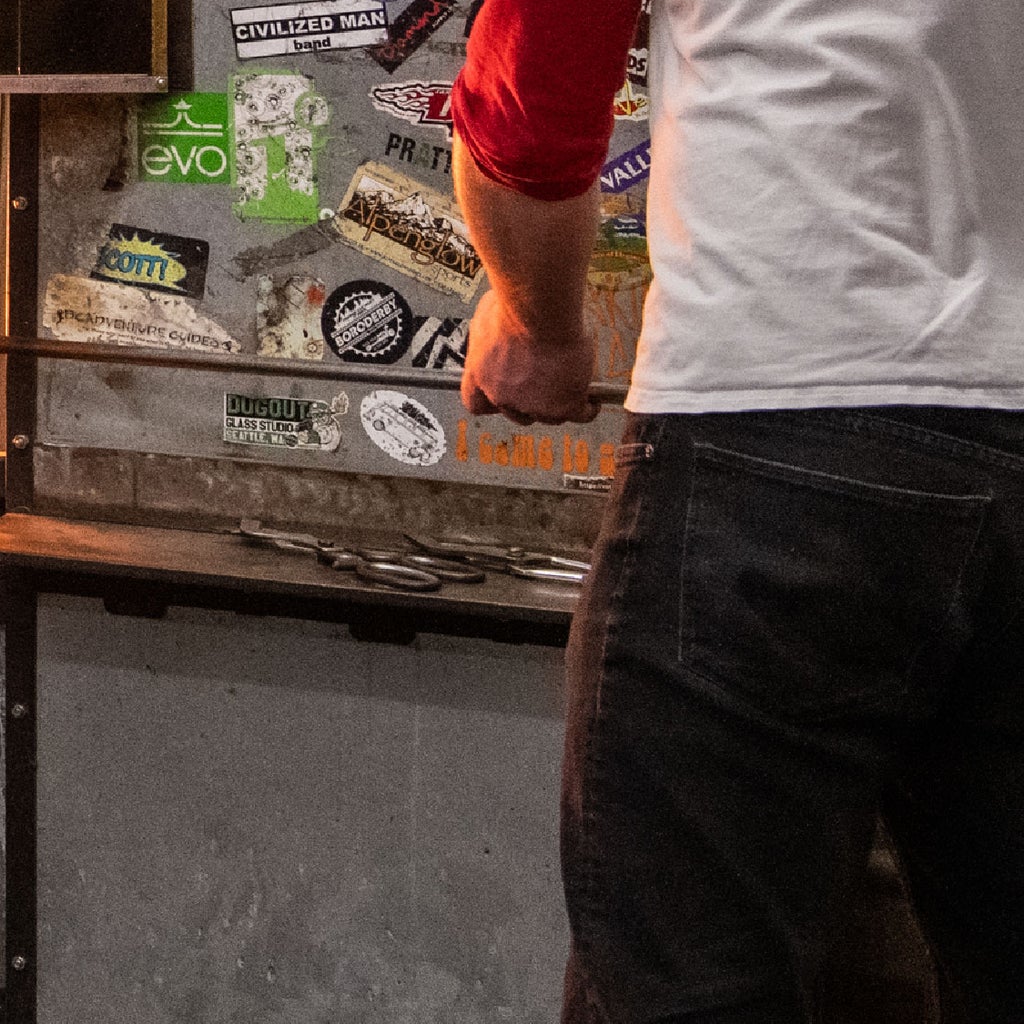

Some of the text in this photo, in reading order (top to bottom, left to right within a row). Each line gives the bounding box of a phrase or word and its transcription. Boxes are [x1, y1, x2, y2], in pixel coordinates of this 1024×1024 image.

[235, 11, 386, 40] CIVILIZED MAN
[293, 37, 331, 51] band
[142, 145, 226, 176] evo
[601, 147, 651, 189] VALL
[342, 198, 483, 277] Alpenglow
[335, 298, 397, 347] BORODERBY
[227, 394, 310, 419] DUGOUT
[226, 418, 295, 433] GLASS STUDIO
